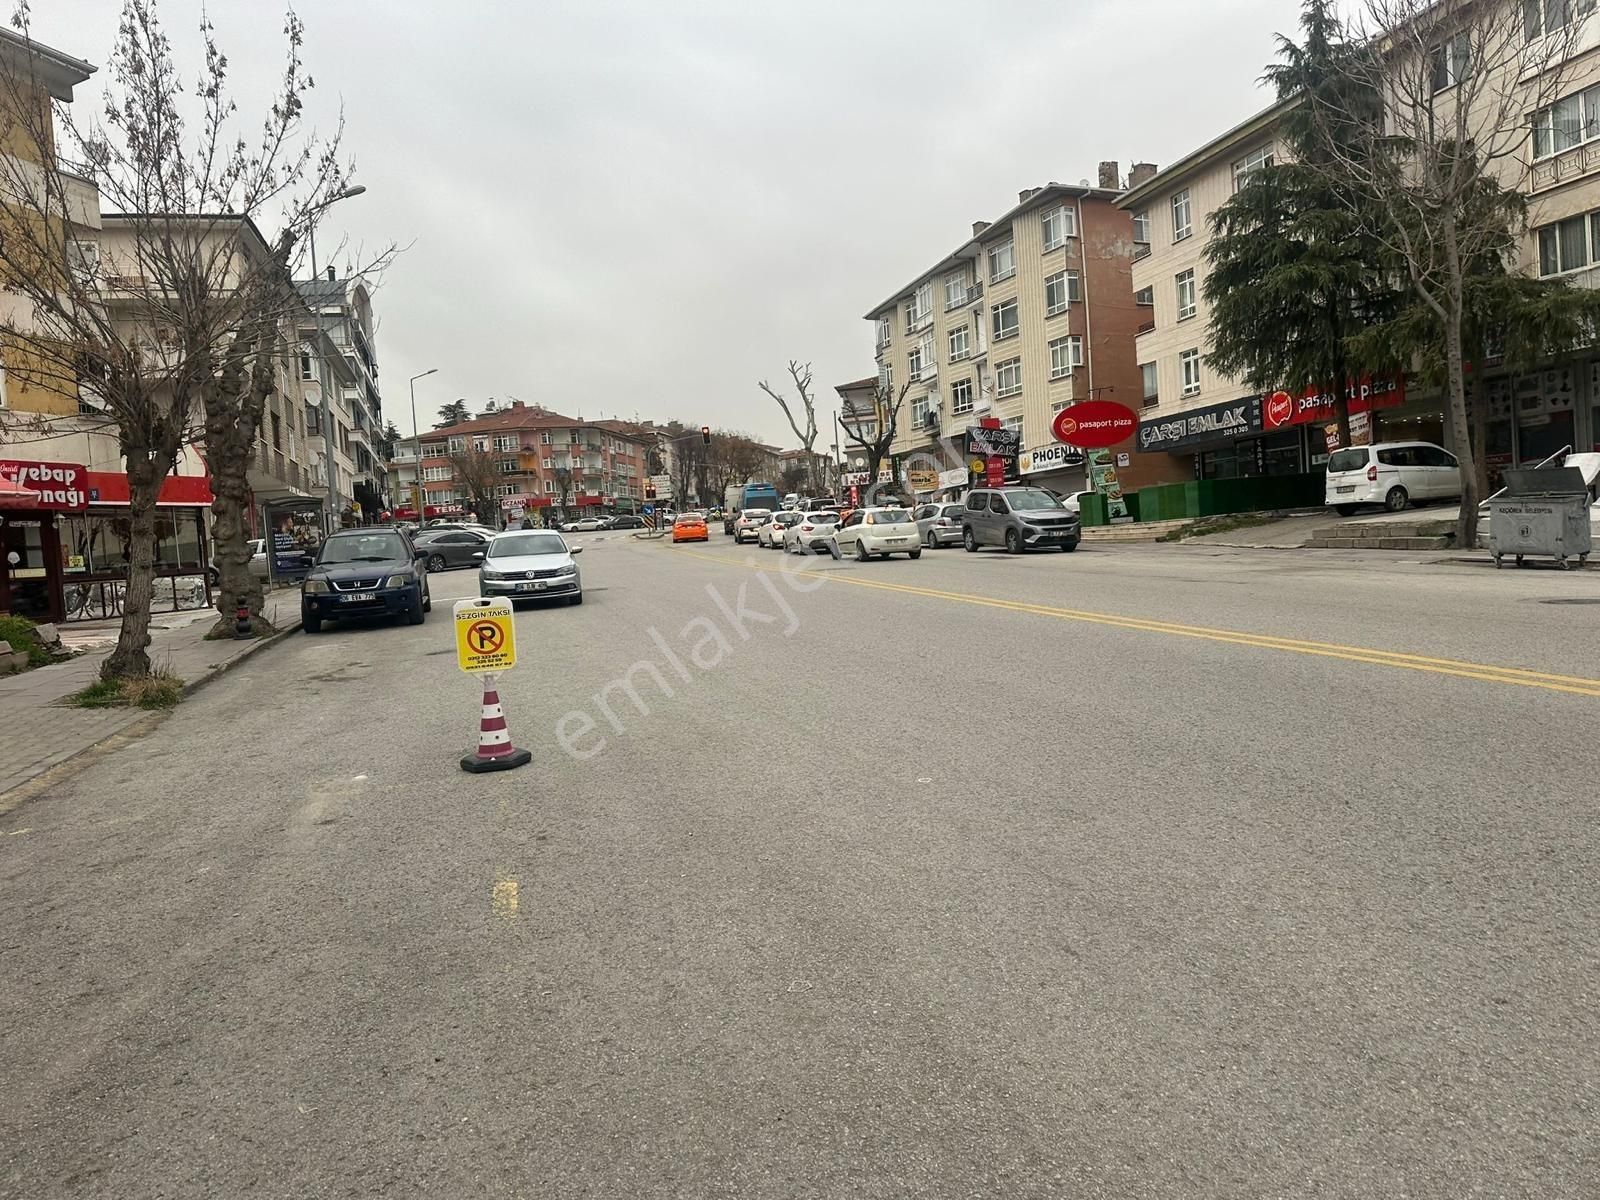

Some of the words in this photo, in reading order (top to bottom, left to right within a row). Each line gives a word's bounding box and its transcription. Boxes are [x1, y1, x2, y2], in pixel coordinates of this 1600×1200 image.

[1299, 384, 1355, 413] pasaprt
[1080, 420, 1111, 429] pasaport
[1114, 419, 1132, 427] pizza
[1140, 419, 1187, 448] ÇARŞI
[1188, 406, 1247, 435] EMLAK
[973, 429, 1016, 444] ÇARŞI
[969, 441, 1017, 457] EMLAK
[1032, 444, 1080, 463] PHOENIX
[38, 487, 84, 507] nağı
